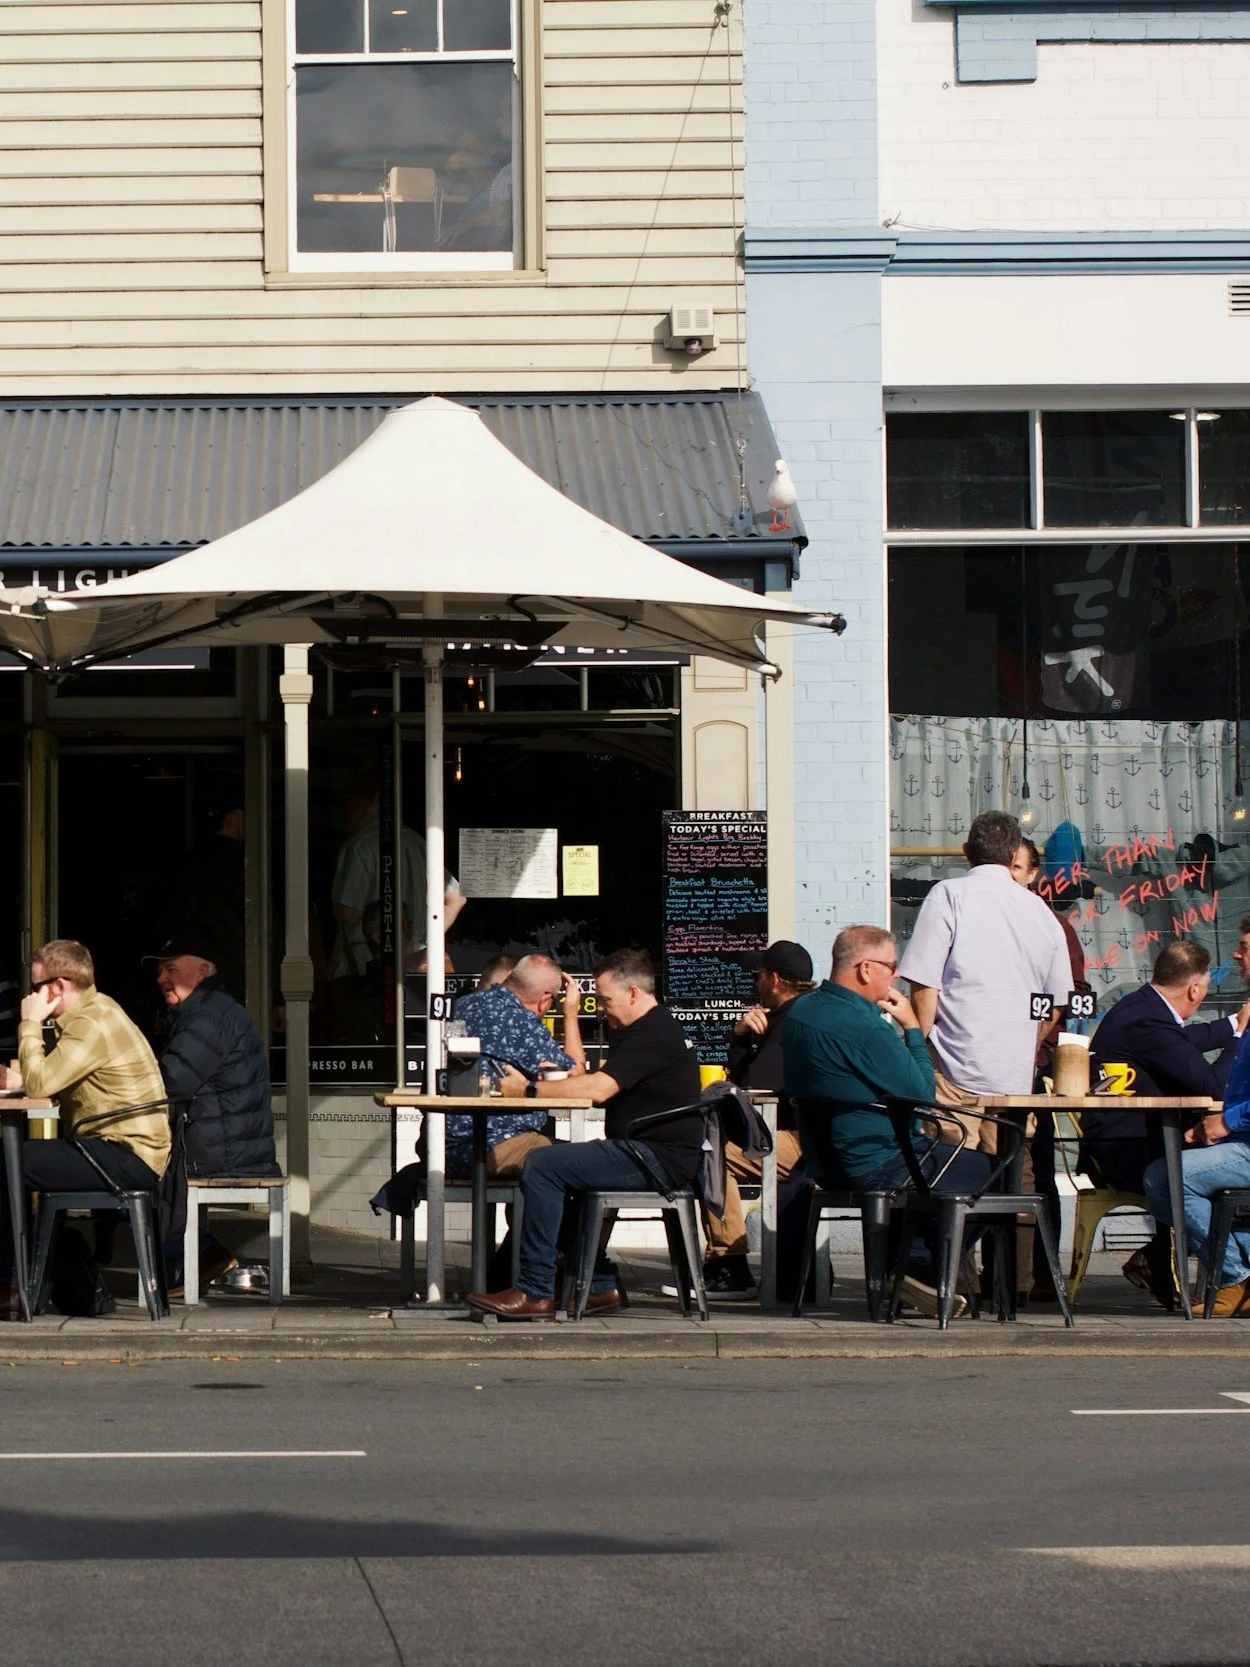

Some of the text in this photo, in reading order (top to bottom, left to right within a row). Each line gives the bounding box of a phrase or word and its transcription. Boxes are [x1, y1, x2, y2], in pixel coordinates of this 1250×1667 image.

[32, 569, 144, 592] LIGH
[689, 812, 753, 820] BREAKFAST
[670, 825, 717, 833] TODAY'S
[698, 834, 719, 843] Lights
[1101, 825, 1175, 876] THAN
[669, 876, 755, 886] Breakfast Bruschetta
[1119, 853, 1209, 911] FRIDAY
[382, 855, 393, 954] PASTA
[1133, 931, 1161, 952] ON
[1171, 890, 1219, 937] NOW
[433, 996, 451, 1018] 91
[704, 999, 741, 1008] LUNCH
[1032, 996, 1051, 1018] 92
[1071, 994, 1094, 1016] 93
[700, 1021, 733, 1033] Scallops
[351, 1060, 374, 1070] BAR
